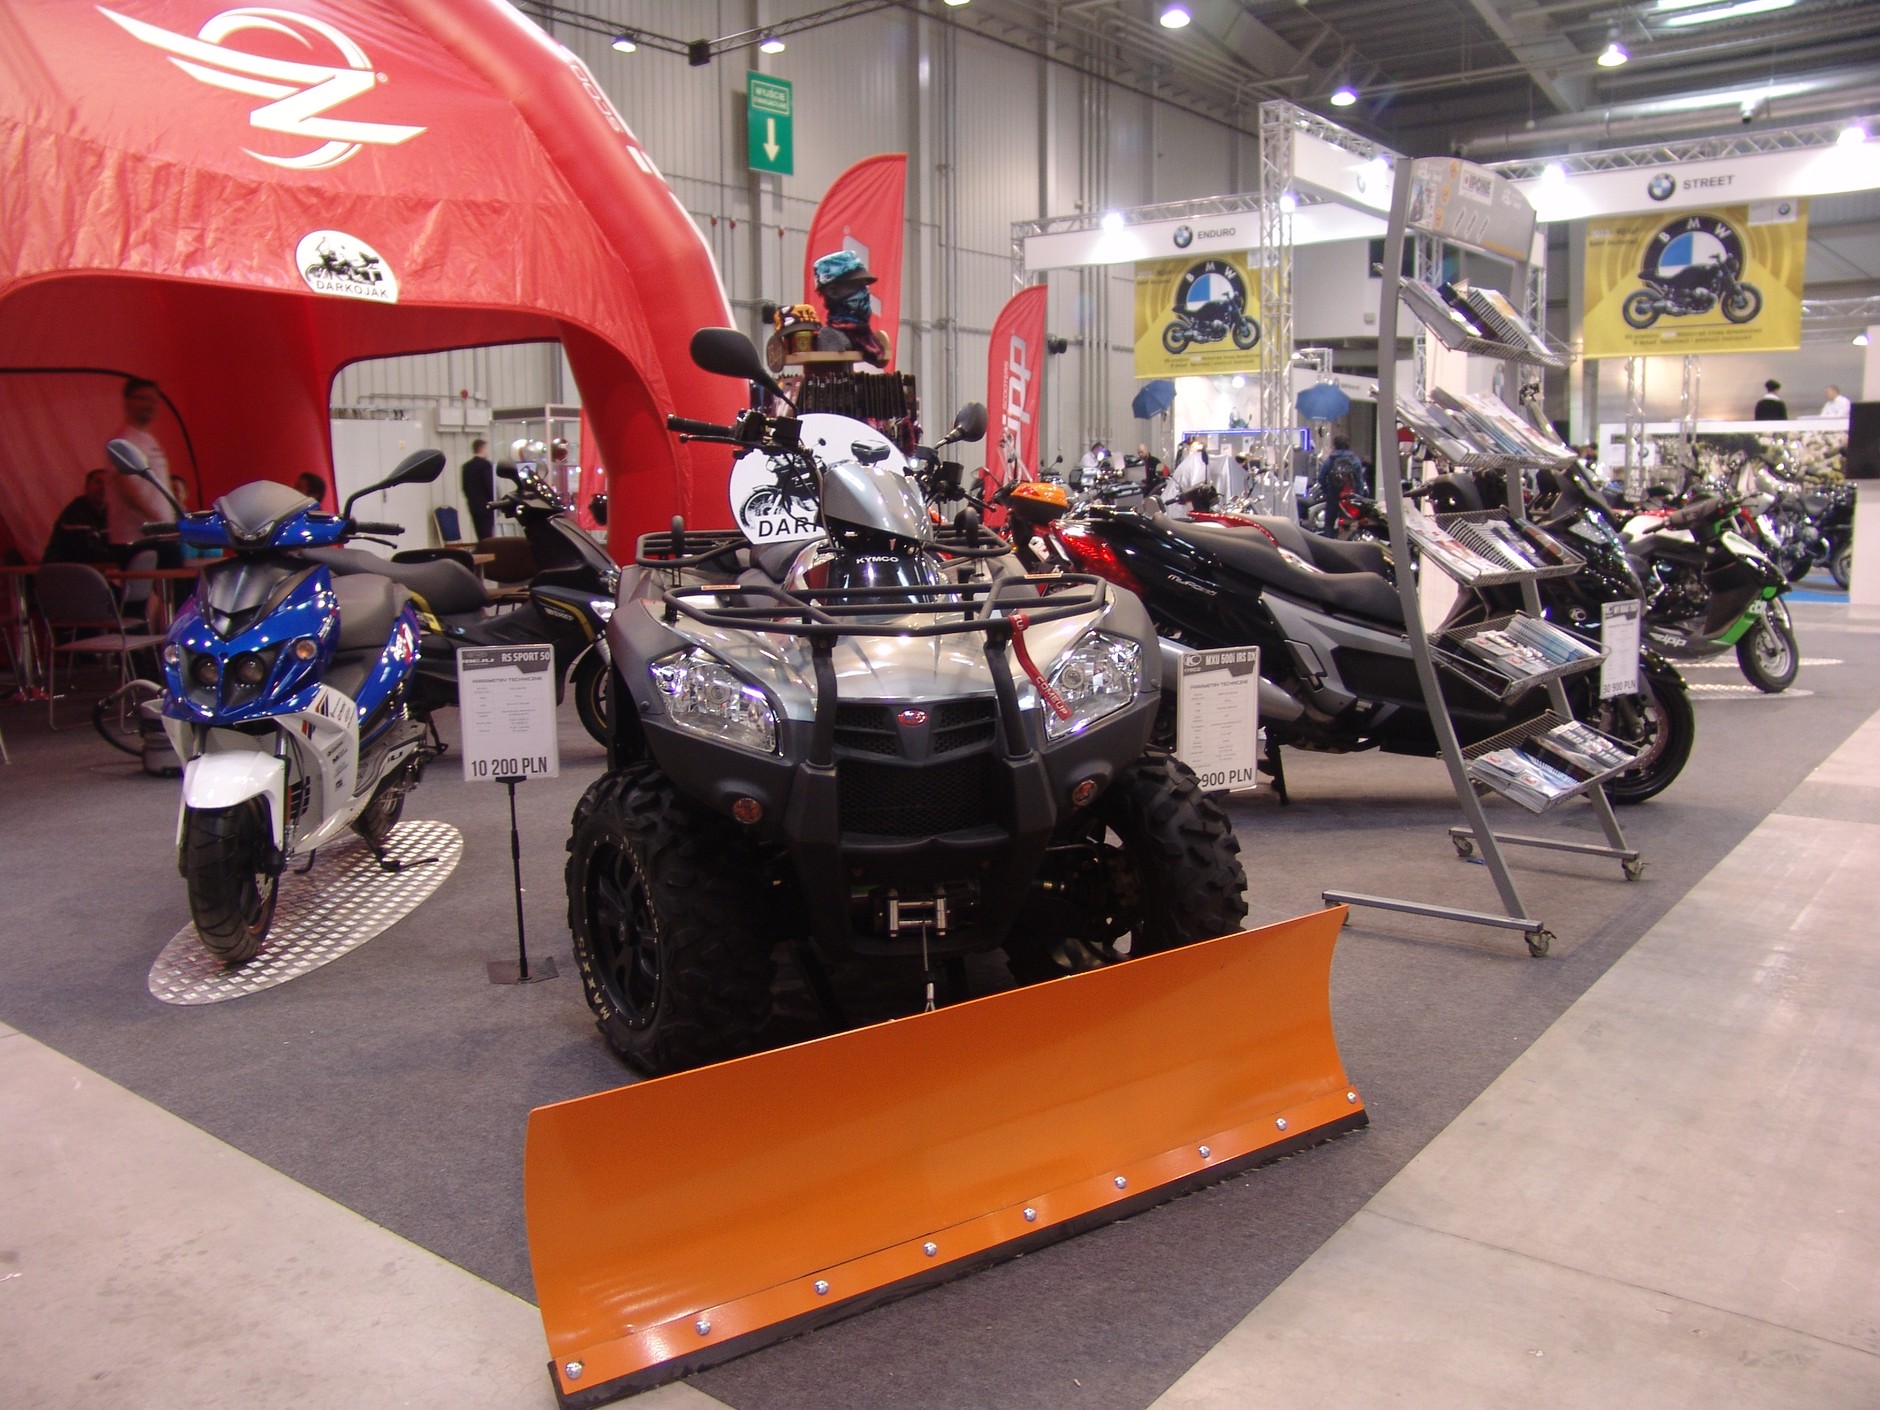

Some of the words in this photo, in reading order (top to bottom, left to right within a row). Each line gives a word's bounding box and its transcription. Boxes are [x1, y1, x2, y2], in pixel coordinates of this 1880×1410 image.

[1683, 175, 1735, 190] STREET
[1197, 228, 1236, 239] ENDURO
[316, 281, 389, 298] DARKOJAK
[856, 556, 899, 564] KYMCO
[502, 653, 512, 662] RS
[513, 652, 539, 661] SPORT
[541, 651, 550, 660] 50
[1035, 676, 1068, 714] COMEUP
[471, 760, 487, 776] 10
[491, 759, 518, 775] 200
[522, 757, 547, 773] PLN
[1228, 768, 1252, 784] PLN
